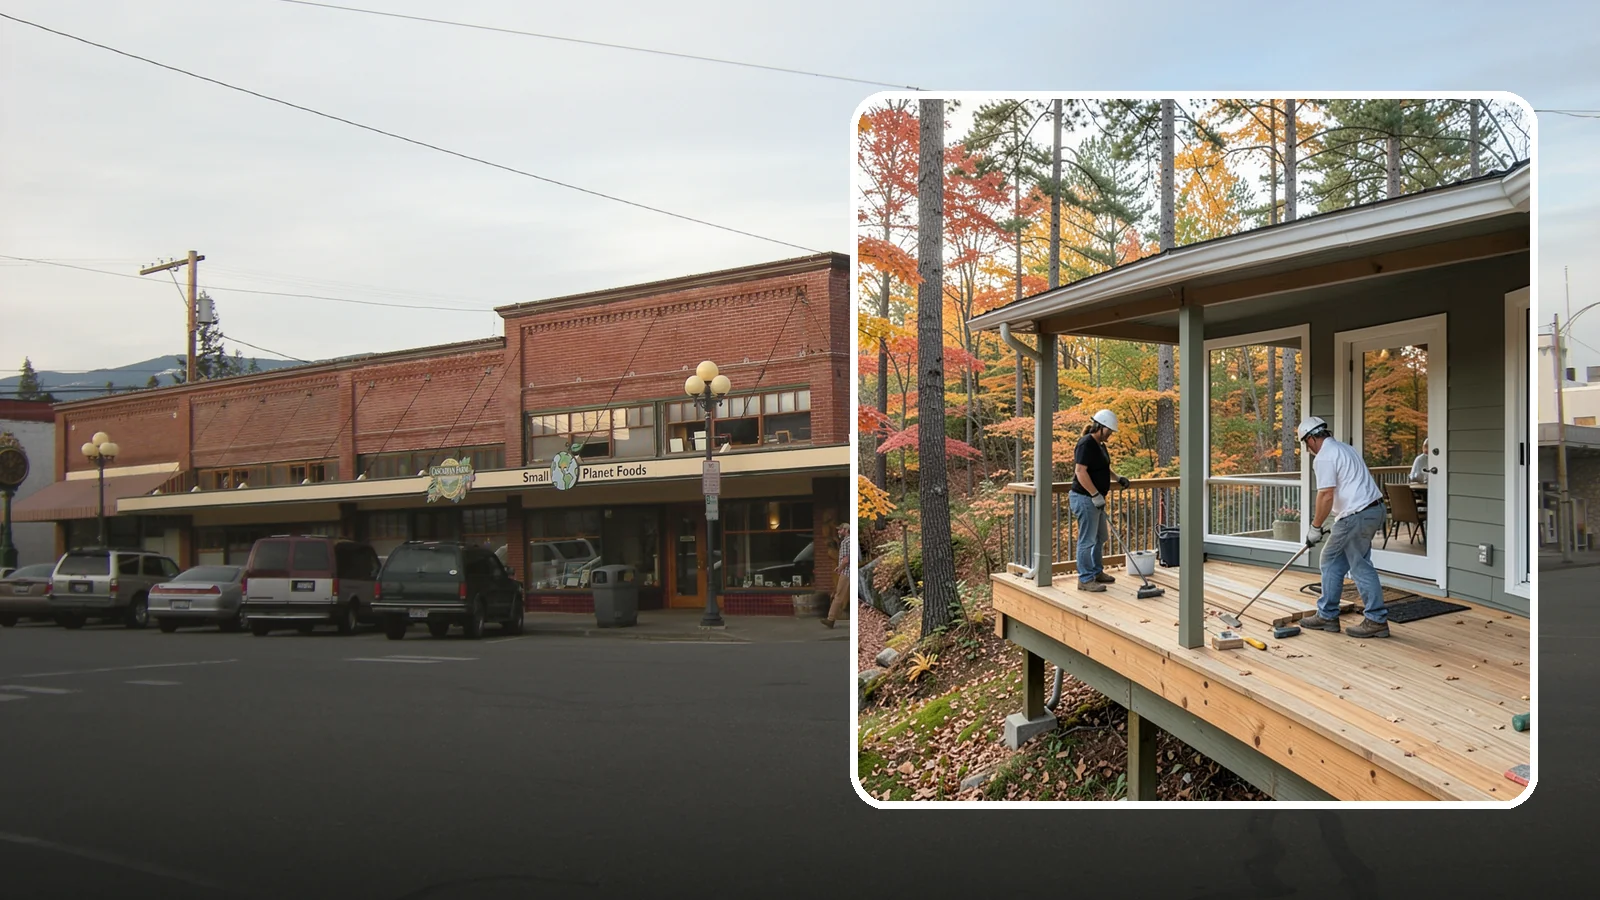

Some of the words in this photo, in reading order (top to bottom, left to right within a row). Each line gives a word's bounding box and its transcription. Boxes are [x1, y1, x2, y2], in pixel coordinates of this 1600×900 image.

[523, 471, 549, 483] Small
[583, 468, 614, 479] Planet
[617, 464, 647, 477] Foods
